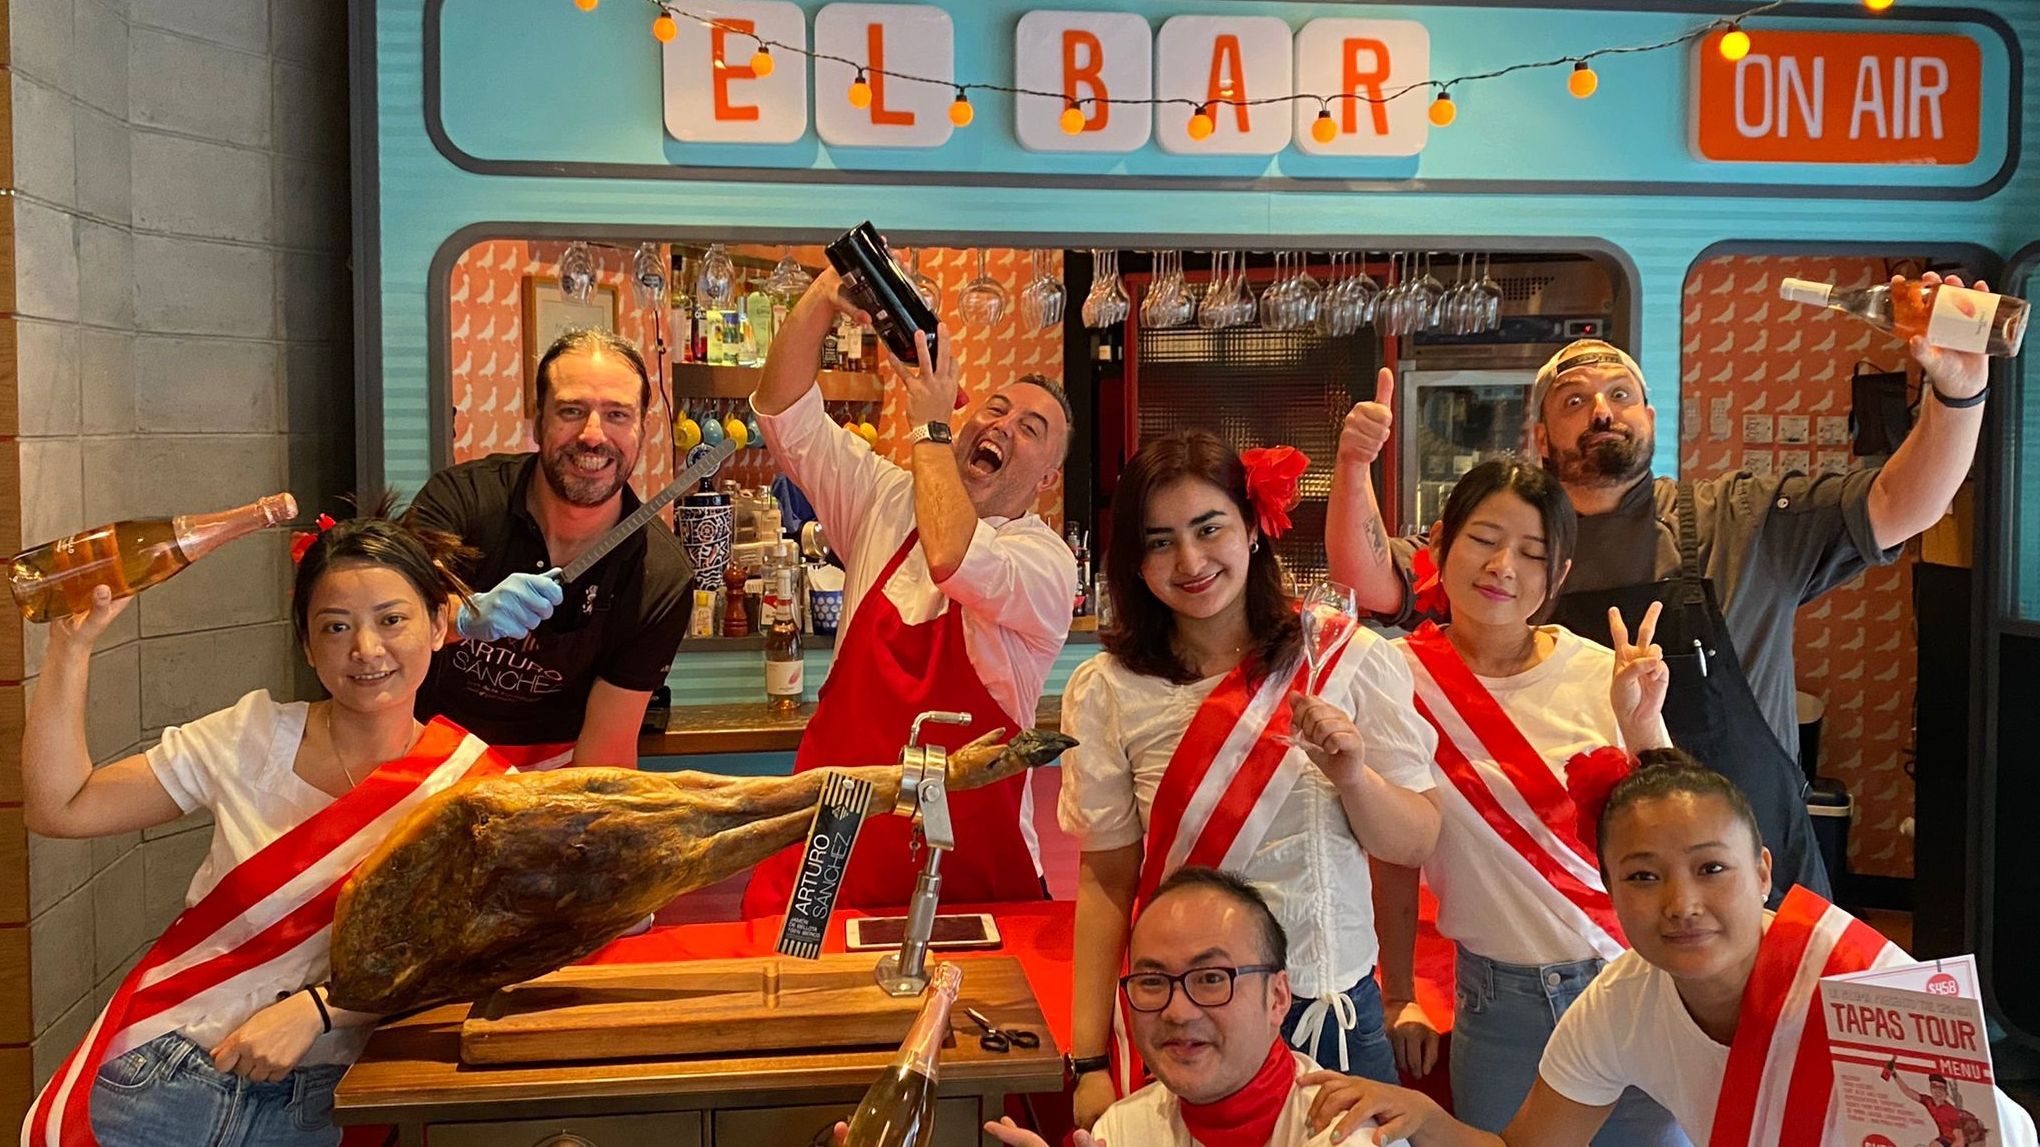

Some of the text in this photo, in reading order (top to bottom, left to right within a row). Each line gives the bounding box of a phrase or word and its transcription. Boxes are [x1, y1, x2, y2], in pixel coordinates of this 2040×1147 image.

[711, 18, 1390, 135] EL BAR
[1735, 55, 1947, 139] ON AIR
[795, 833, 830, 916] ARTURO
[812, 831, 852, 919] SÁNCHEZ
[1831, 1002, 1905, 1041] TAPAS
[1909, 1013, 1976, 1050] TOUR
[1940, 1058, 1982, 1080] MENU
